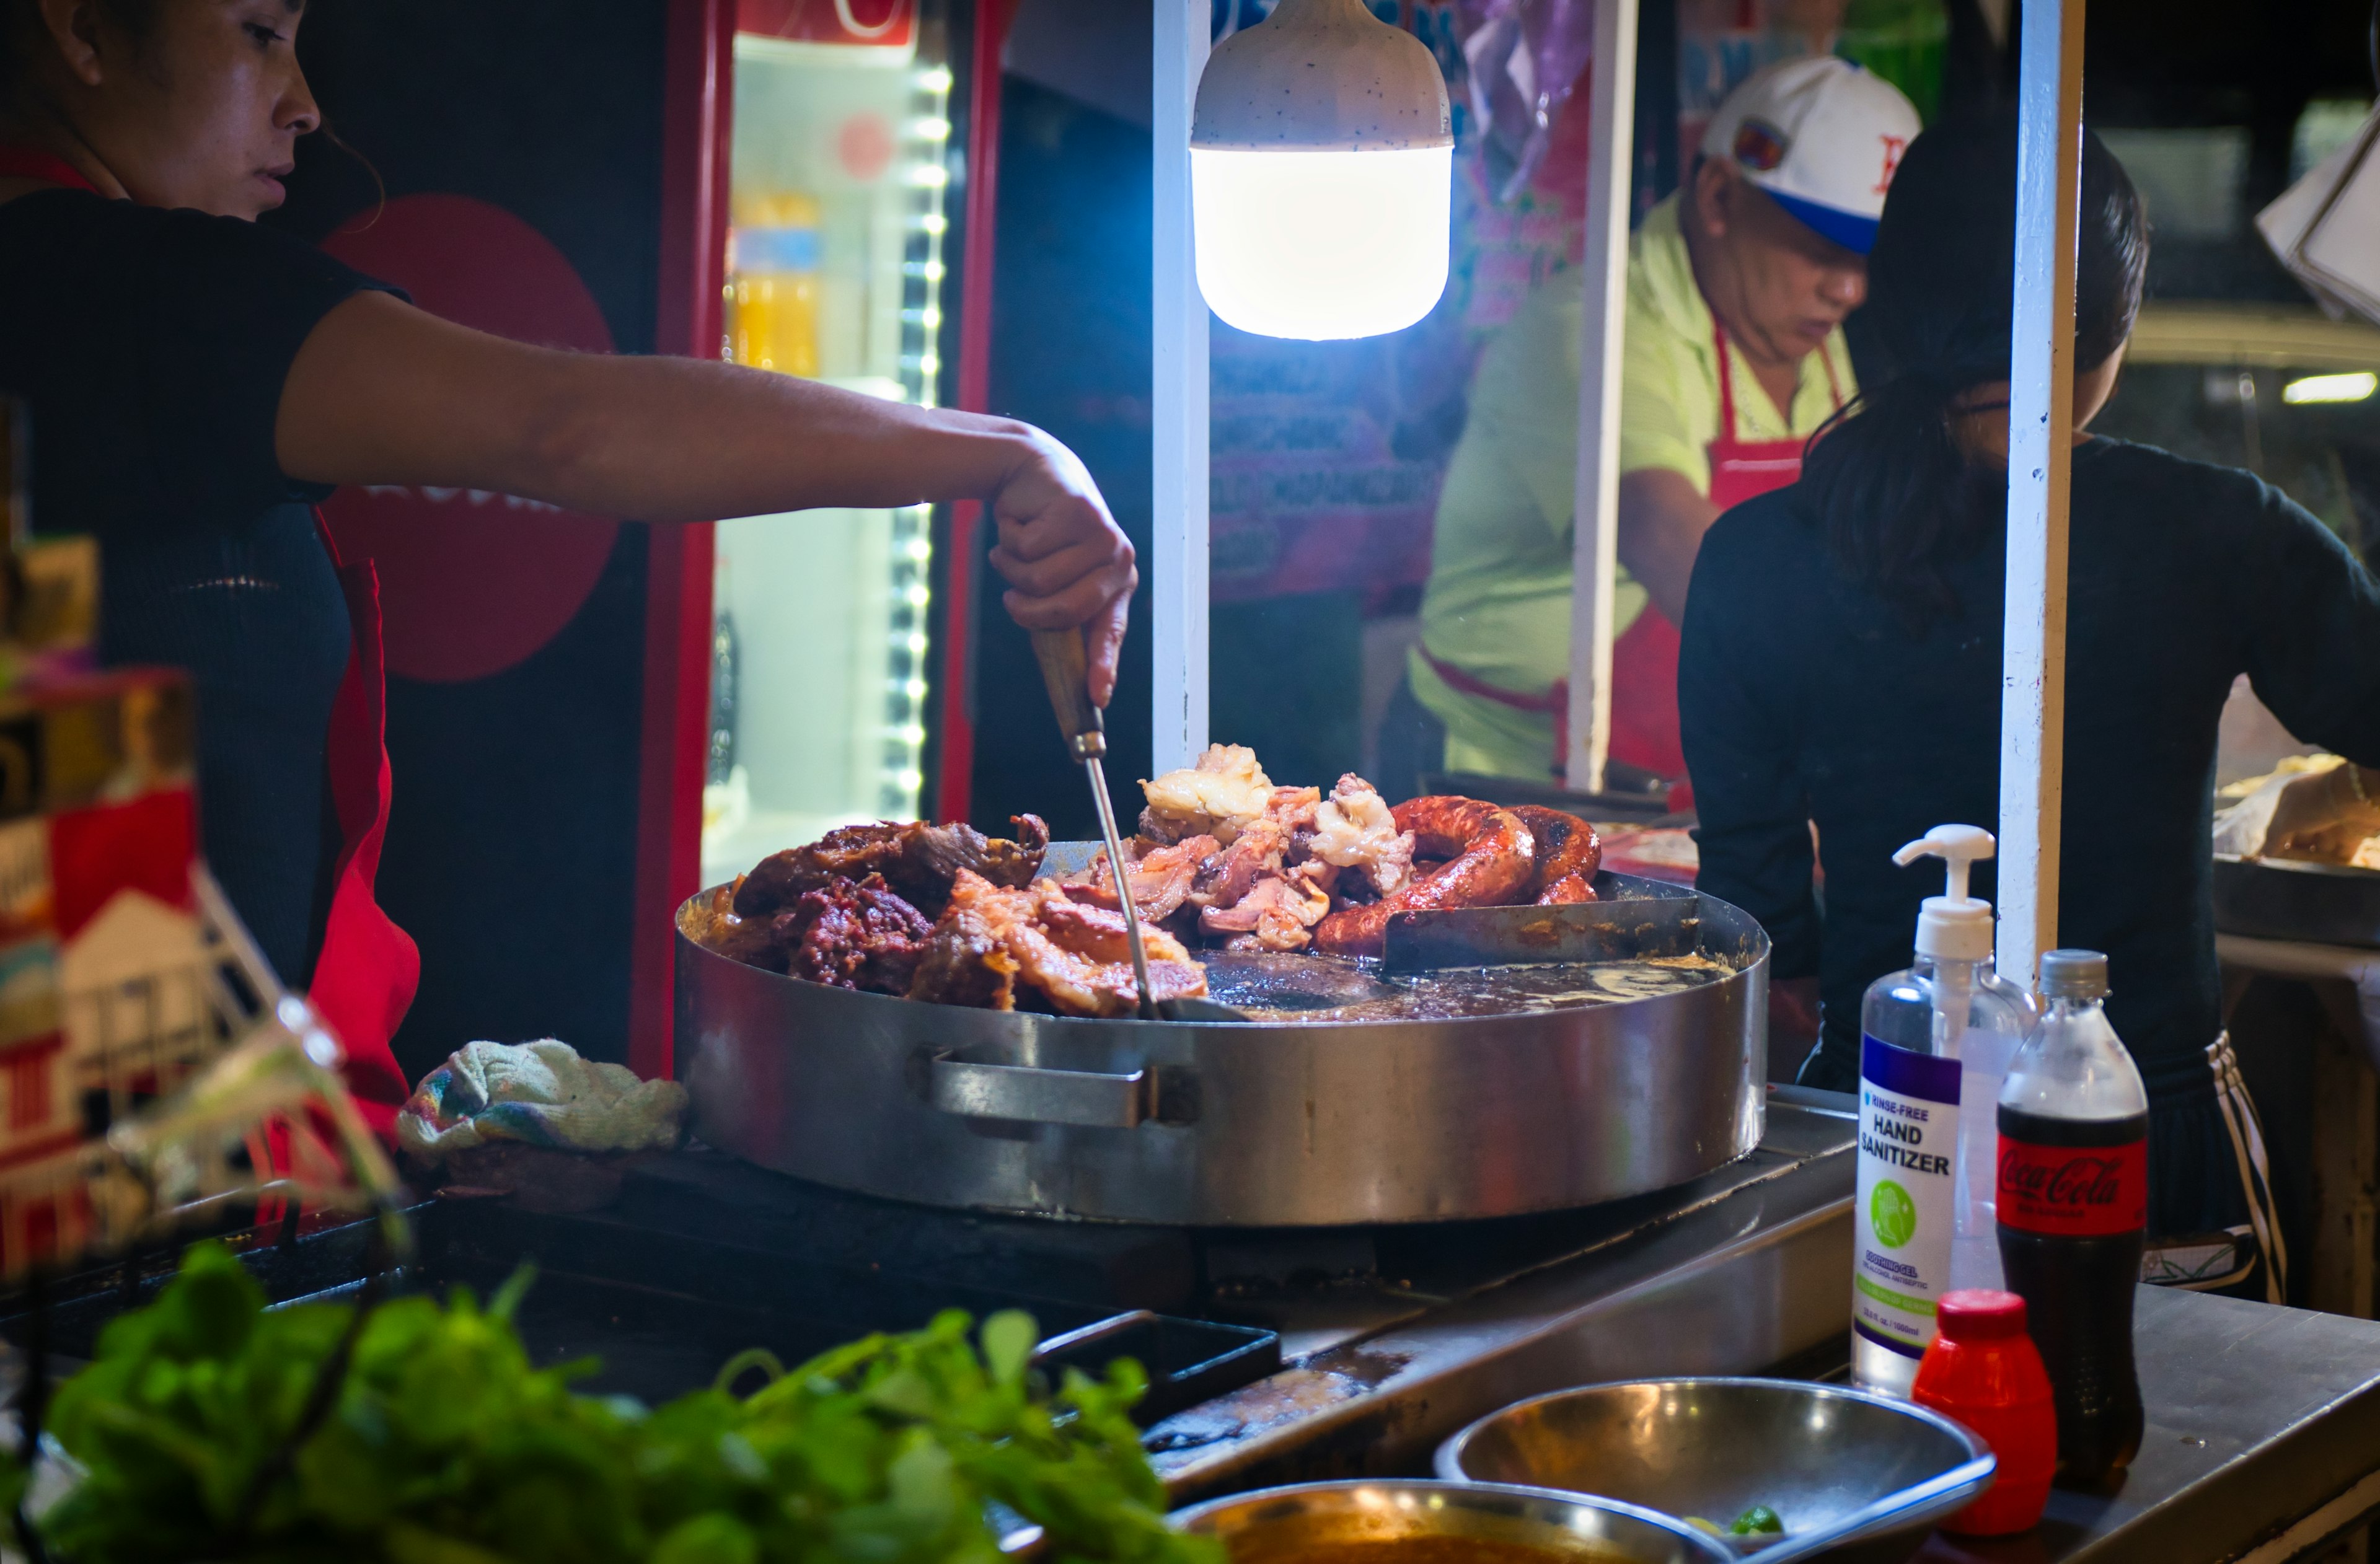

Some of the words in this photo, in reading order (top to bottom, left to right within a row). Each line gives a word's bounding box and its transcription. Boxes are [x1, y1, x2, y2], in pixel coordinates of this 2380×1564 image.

[1872, 1094, 1928, 1122] RINSE-FREE
[1874, 1114, 1922, 1144] HAND
[1861, 1132, 1949, 1175] SANITIZER
[1866, 1249, 1900, 1273] SOOTHING
[1899, 1263, 1918, 1278] GEL
[1891, 1275, 1928, 1289] ANTISEPTIC
[1893, 1321, 1919, 1336] 1000ml
